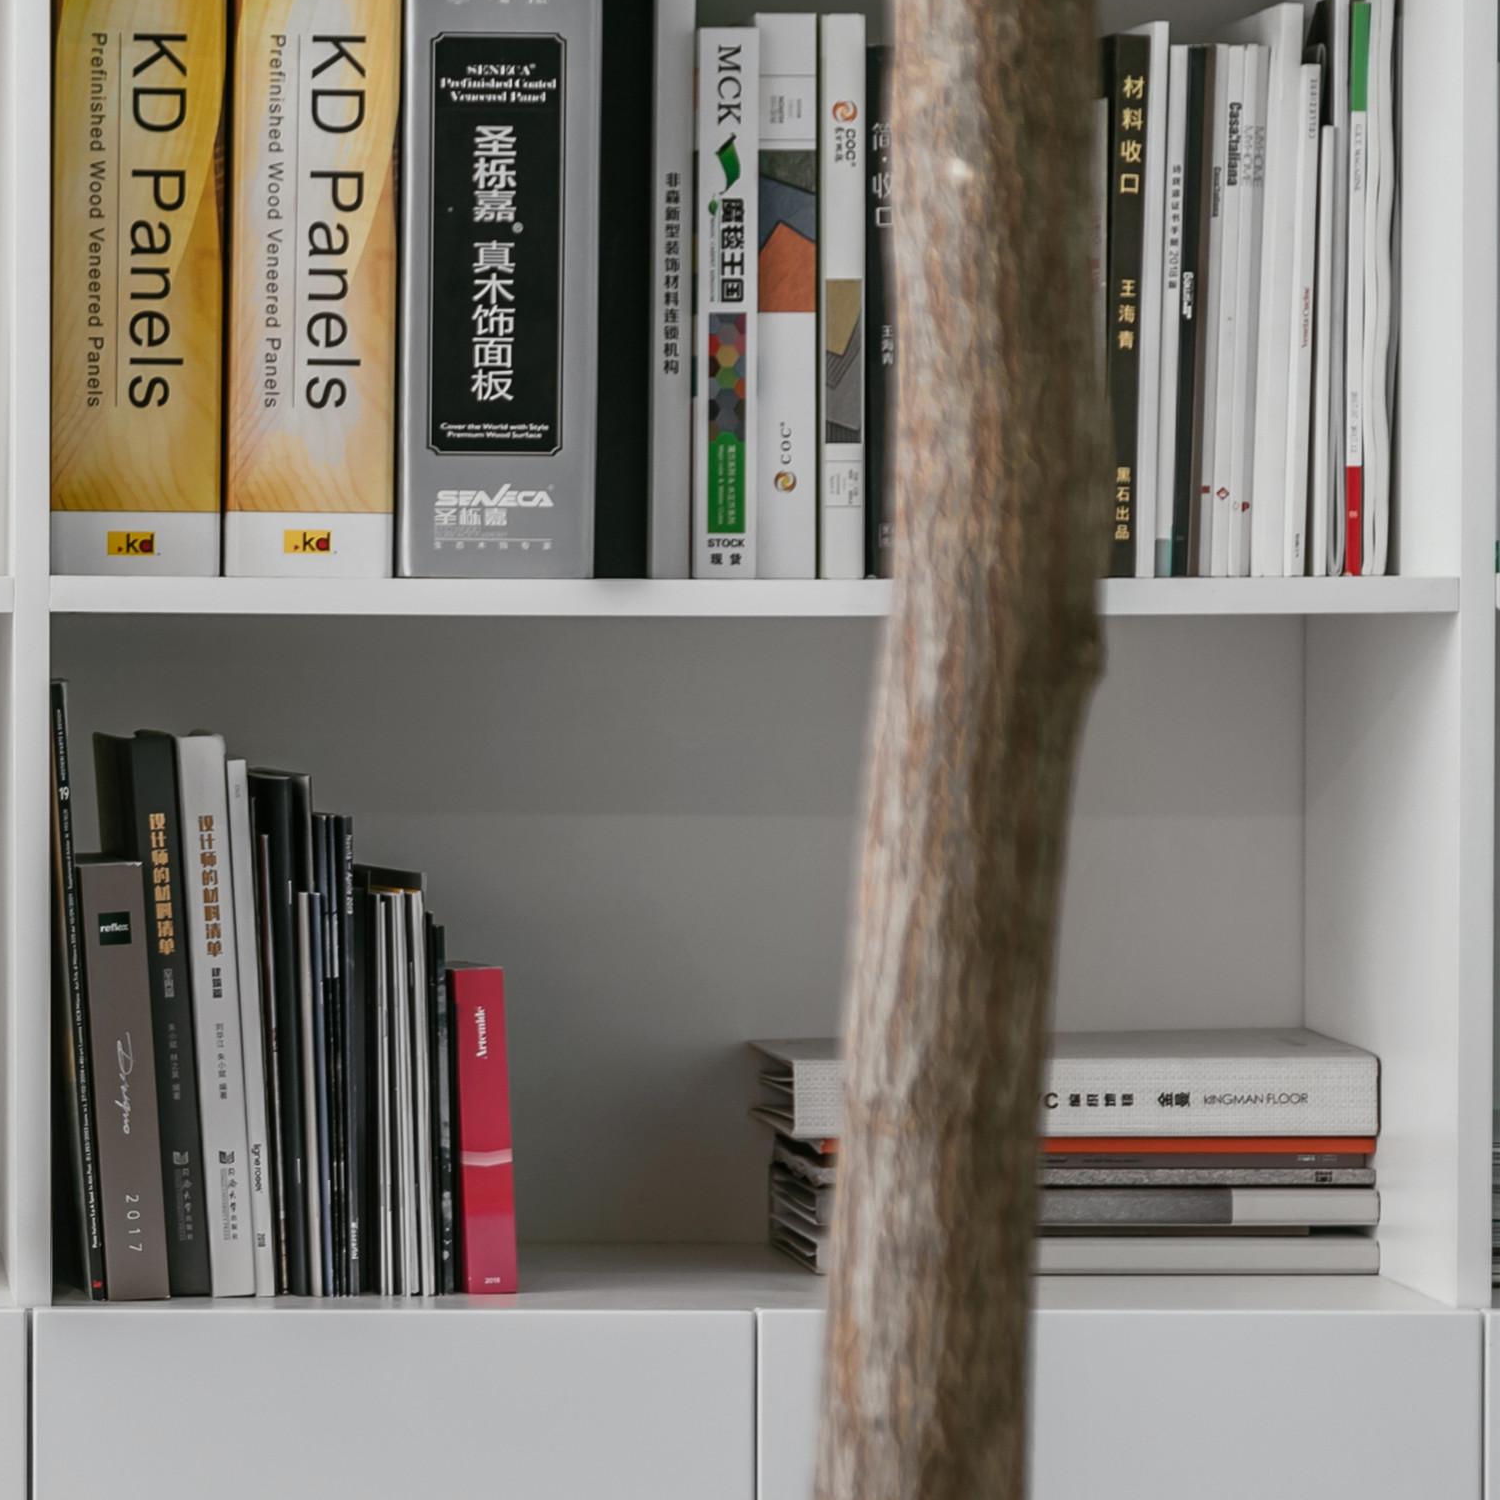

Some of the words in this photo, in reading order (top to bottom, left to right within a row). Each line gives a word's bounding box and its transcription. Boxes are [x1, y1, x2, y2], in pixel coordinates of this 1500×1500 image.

[88, 32, 108, 152] Prefinished
[132, 32, 188, 133] KD
[267, 33, 287, 153] Prefinished
[311, 34, 367, 134] KD
[717, 44, 742, 126] MCK
[845, 128, 856, 161] COC
[1119, 75, 1145, 194] 材料收口
[87, 159, 106, 219] Wood
[266, 161, 285, 221] Wood
[472, 124, 517, 223] 圣栎嘉
[86, 226, 105, 328] Veneered
[127, 168, 187, 409] Panels
[264, 228, 283, 329] Veneered
[305, 170, 365, 410] Panels
[471, 240, 516, 401] 真木饰面板
[1118, 279, 1136, 350] 王海青
[86, 335, 104, 407] Panels
[264, 336, 282, 408] Panels
[510, 423, 528, 431] with
[529, 423, 550, 431] Style
[434, 484, 554, 508] SENECA
[1115, 466, 1131, 540] 黑石出品
[708, 538, 745, 548] STOCK
[59, 786, 70, 800] 19
[100, 922, 129, 932] reflex
[474, 1005, 488, 1058] Artemide
[1203, 1093, 1264, 1106] KINGMAN
[1267, 1092, 1309, 1104] FLOOR
[250, 1143, 262, 1166] ligne
[125, 1193, 143, 1252] 2017
